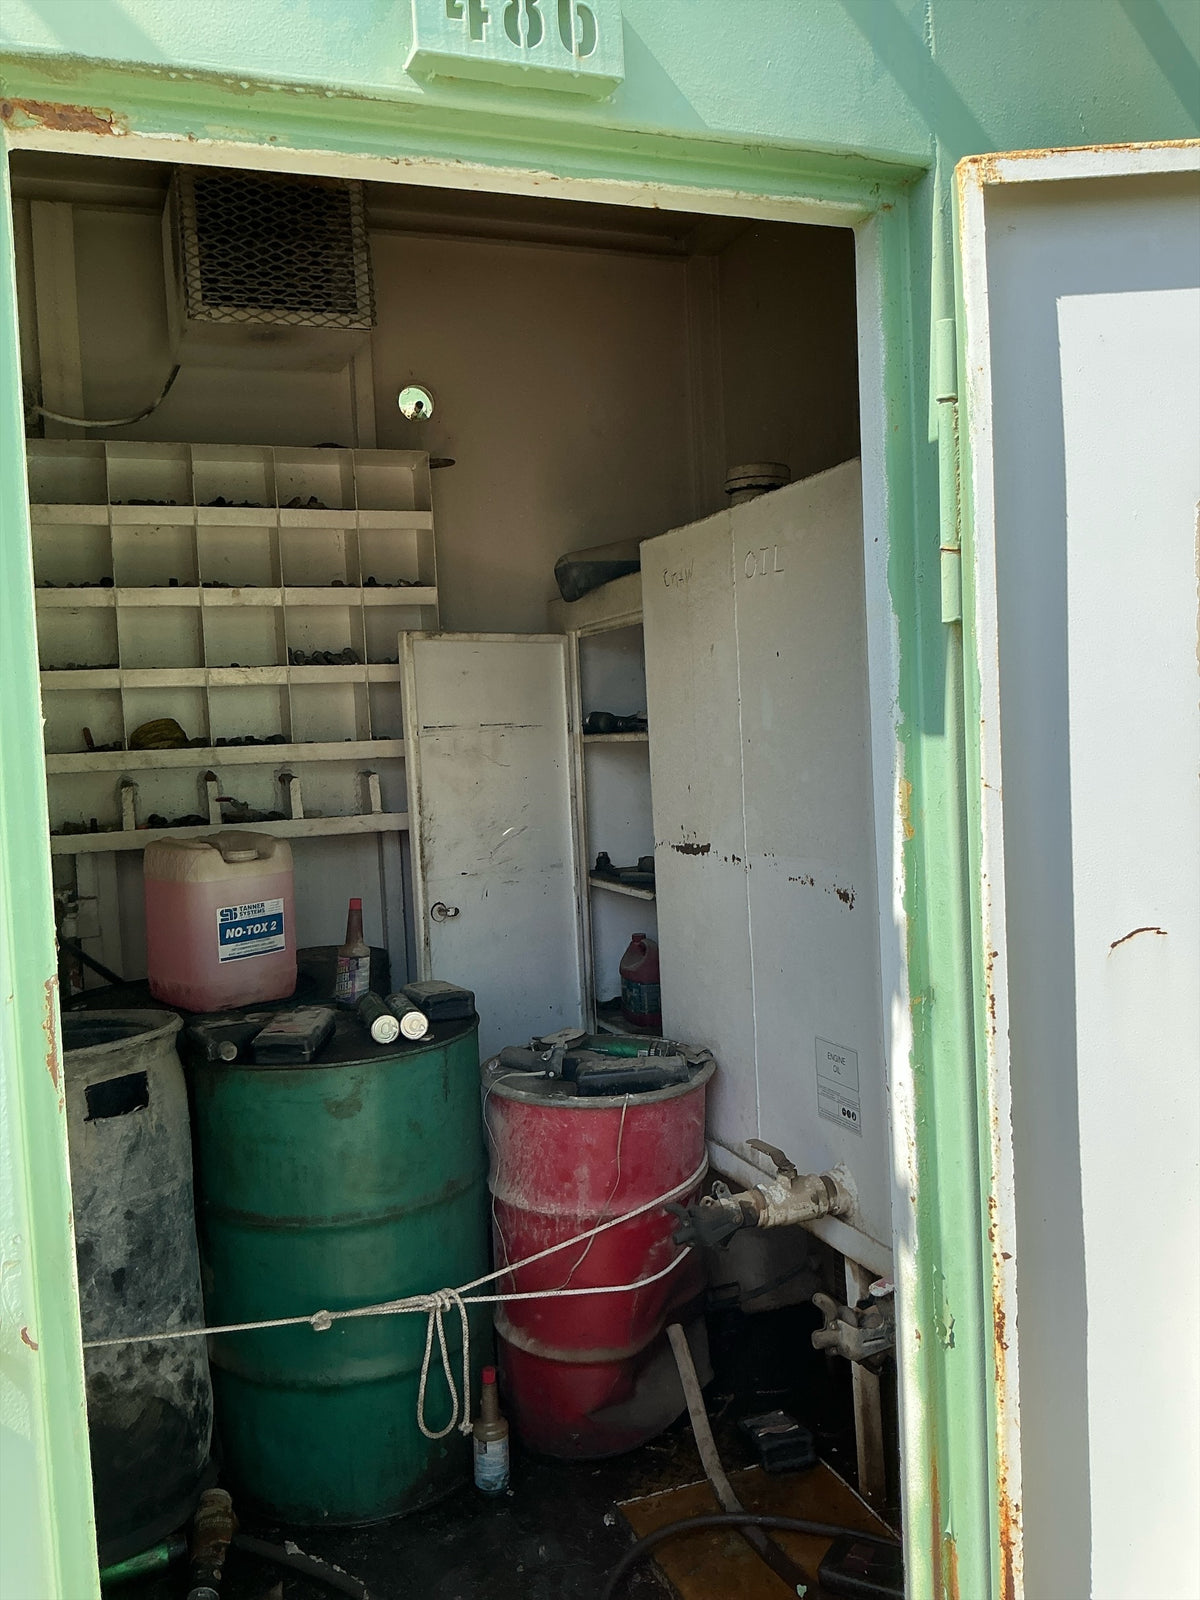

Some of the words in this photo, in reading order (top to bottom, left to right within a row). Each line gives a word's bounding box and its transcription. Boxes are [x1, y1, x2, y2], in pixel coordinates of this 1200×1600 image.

[744, 544, 785, 579] OIL
[239, 902, 265, 912] TANNER
[239, 908, 266, 917] SYSTEMS
[225, 922, 269, 939] NO-TOX
[270, 920, 277, 931] 2
